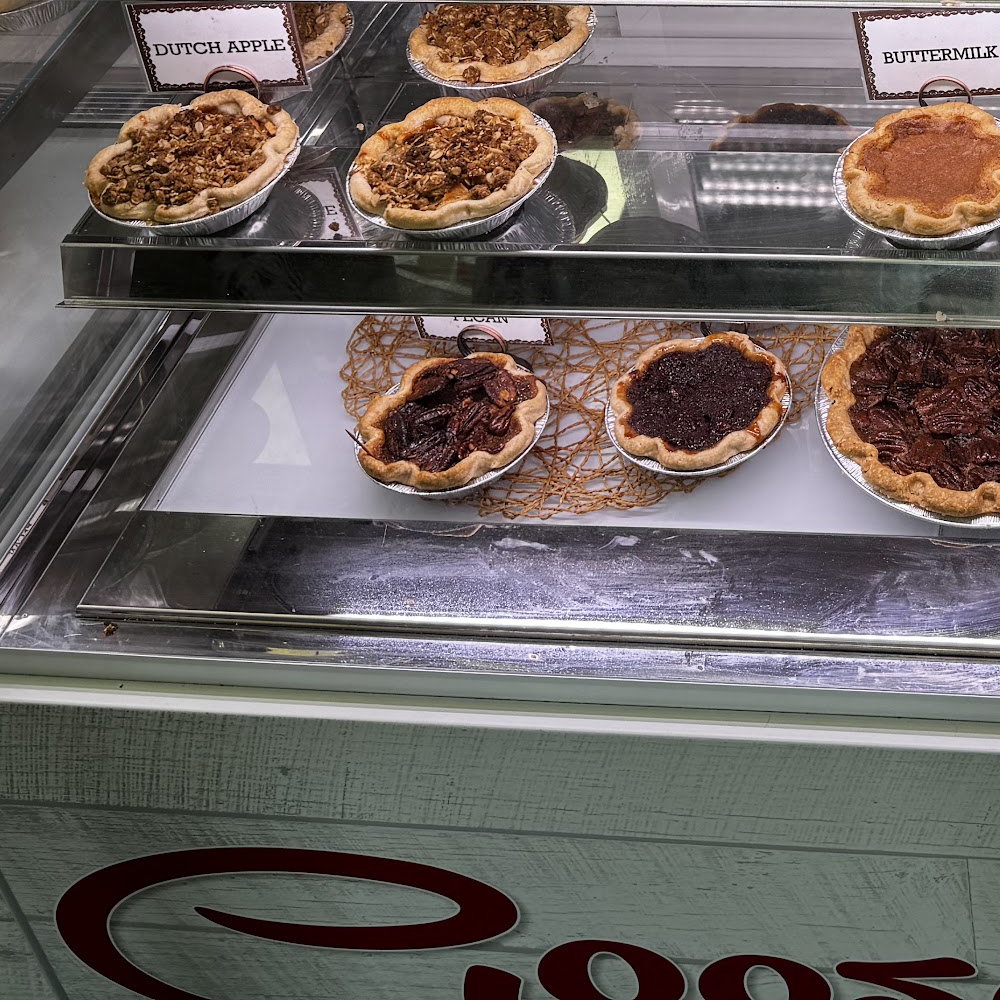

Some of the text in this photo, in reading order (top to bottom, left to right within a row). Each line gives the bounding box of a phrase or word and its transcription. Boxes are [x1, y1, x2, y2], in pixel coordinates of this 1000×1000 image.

[153, 38, 287, 57] DUTCH APPLE
[882, 45, 1000, 65] BUTTERMILK
